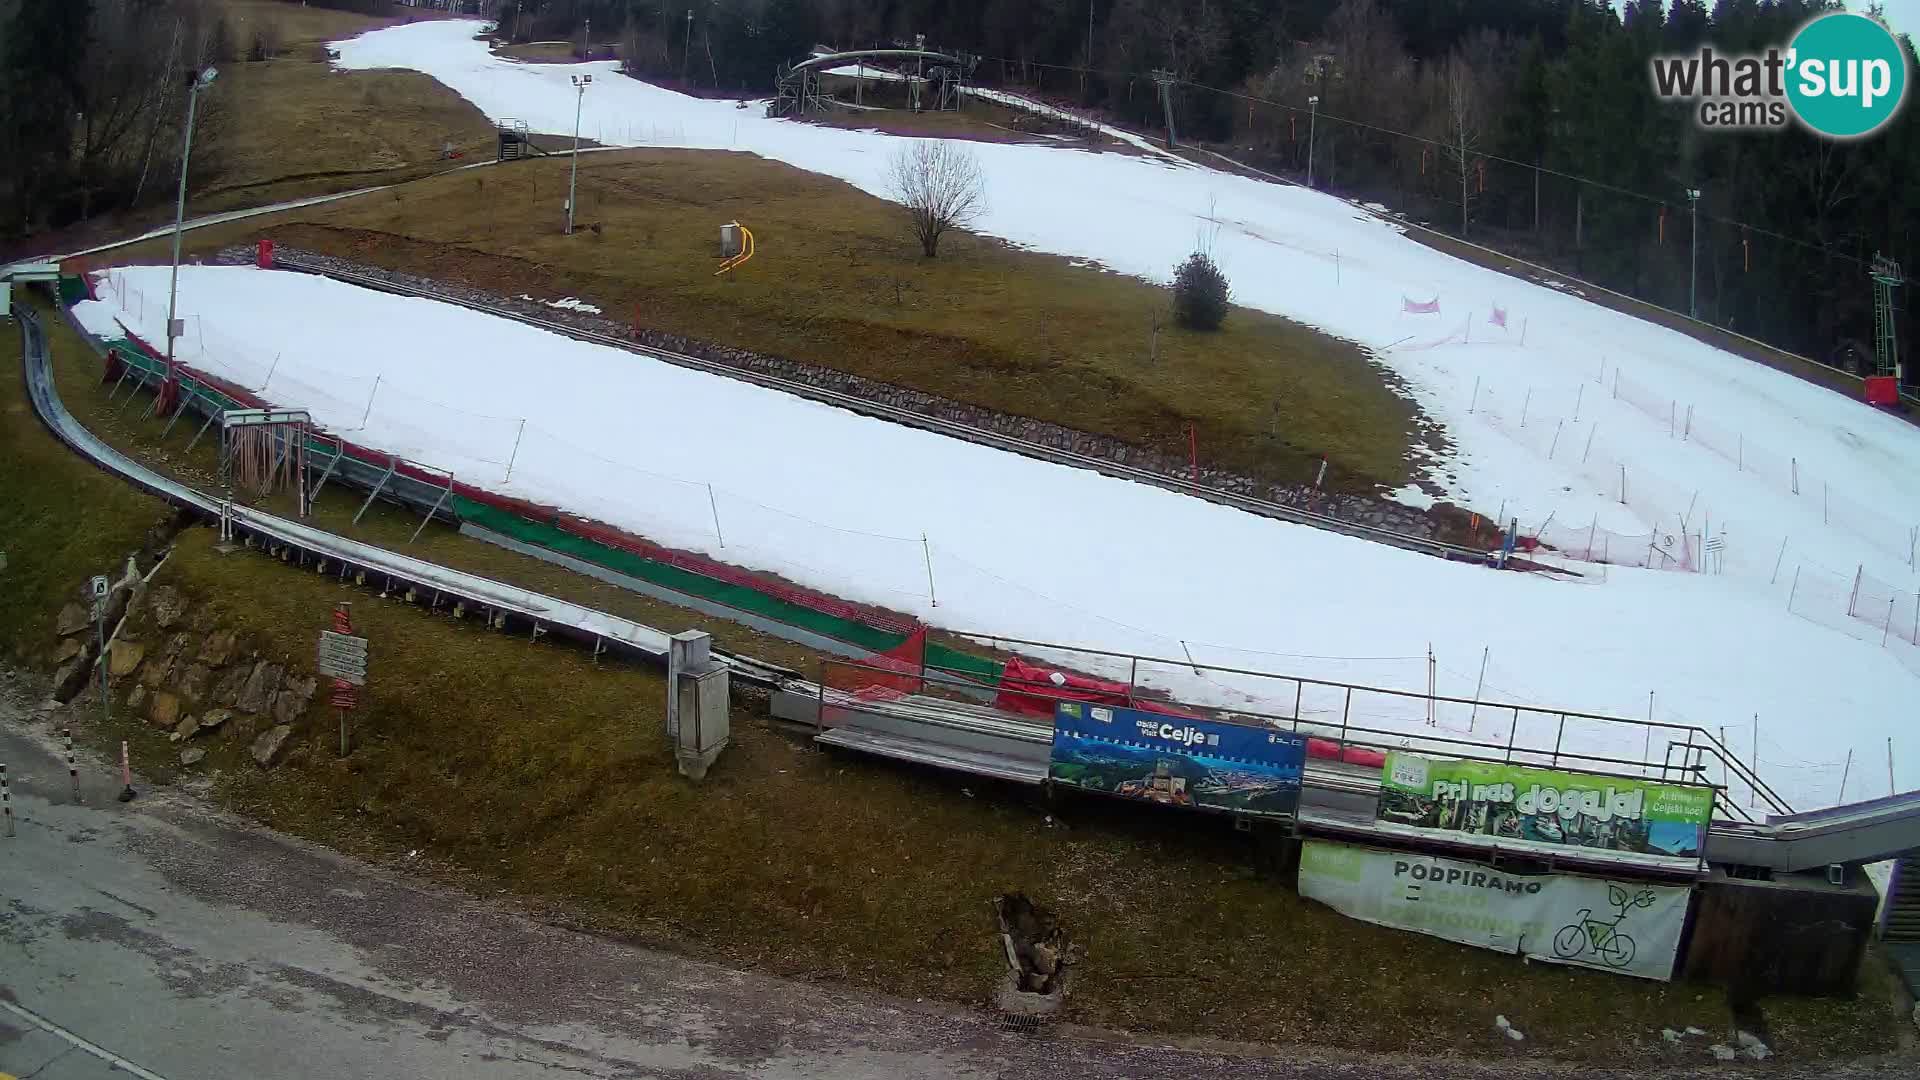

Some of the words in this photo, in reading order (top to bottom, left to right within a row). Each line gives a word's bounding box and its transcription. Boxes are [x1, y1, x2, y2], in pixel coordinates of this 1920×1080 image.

[1159, 723, 1205, 747] Celje
[1472, 782, 1515, 803] nas
[1394, 860, 1542, 895] PODPIRAMO
